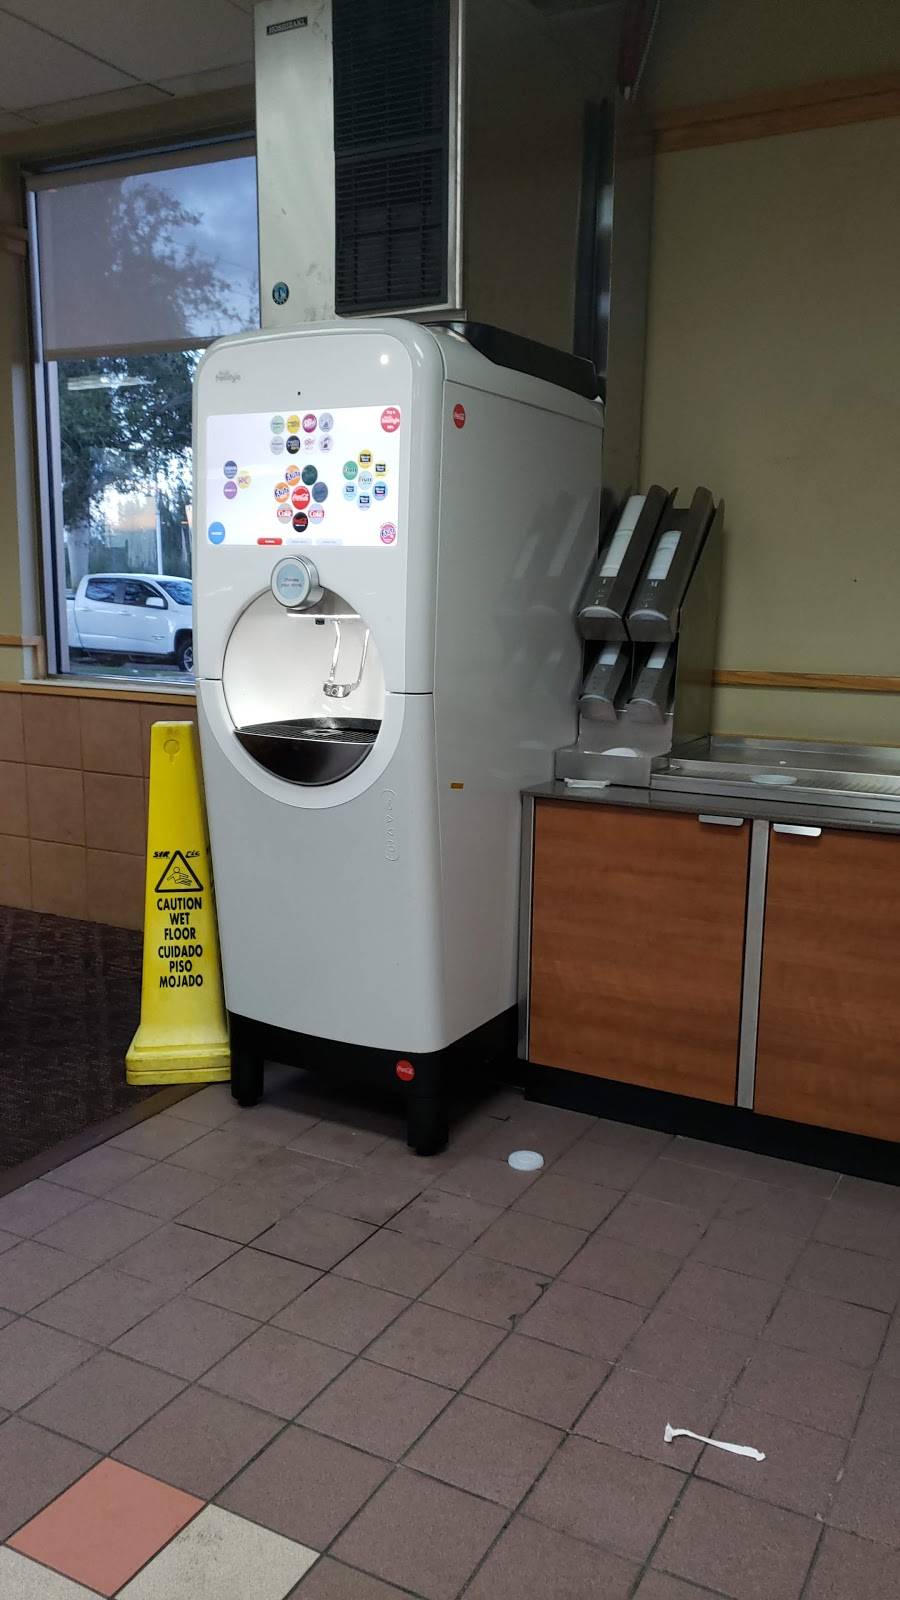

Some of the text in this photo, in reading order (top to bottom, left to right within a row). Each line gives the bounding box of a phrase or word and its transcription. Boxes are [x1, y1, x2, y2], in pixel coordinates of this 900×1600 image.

[157, 896, 202, 910] CAUTION
[169, 912, 190, 925] WET
[164, 927, 196, 940] FLOOR
[158, 944, 203, 958] CUIDADO
[169, 960, 192, 973] PISO
[159, 974, 203, 988] MOJADO
